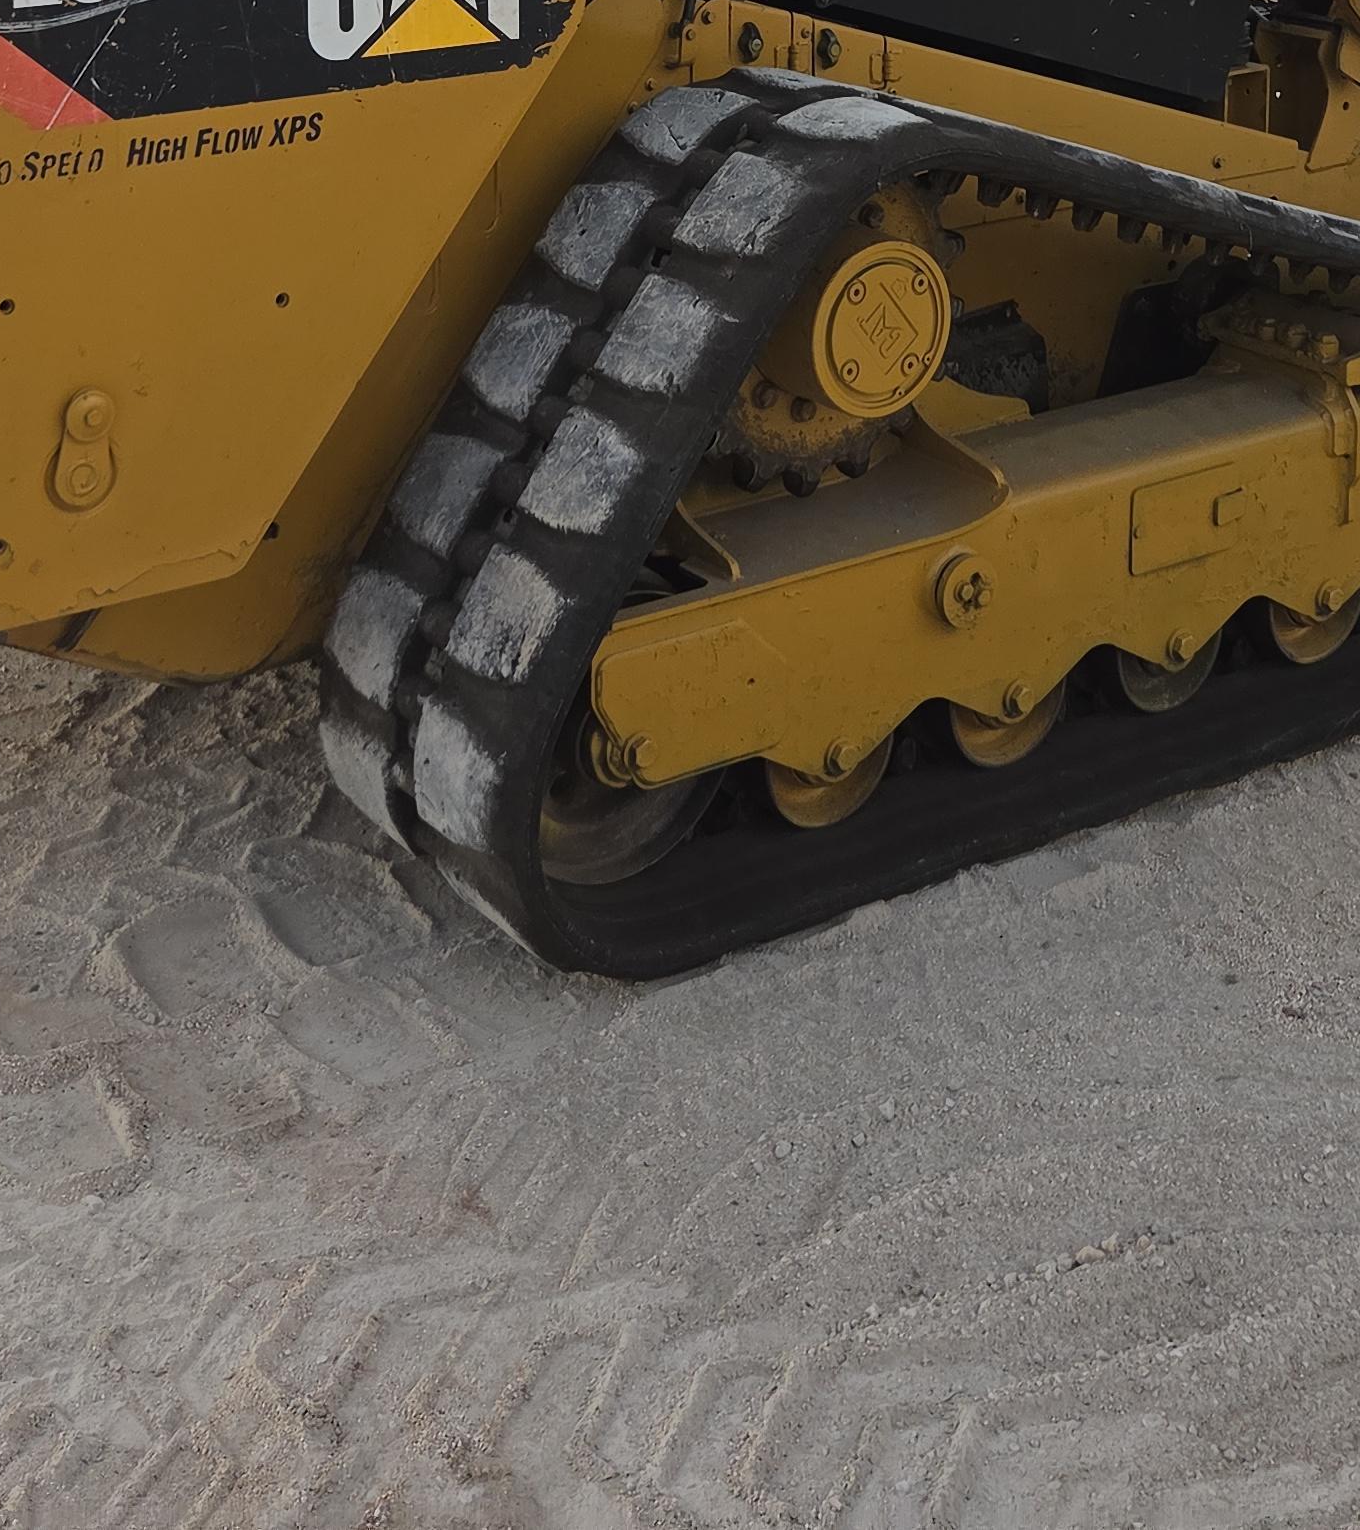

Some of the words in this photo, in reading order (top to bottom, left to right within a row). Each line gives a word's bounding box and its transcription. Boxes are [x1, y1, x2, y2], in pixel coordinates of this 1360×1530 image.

[126, 136, 188, 167] HIGH
[194, 127, 264, 158] FLOW
[268, 112, 324, 147] XPS
